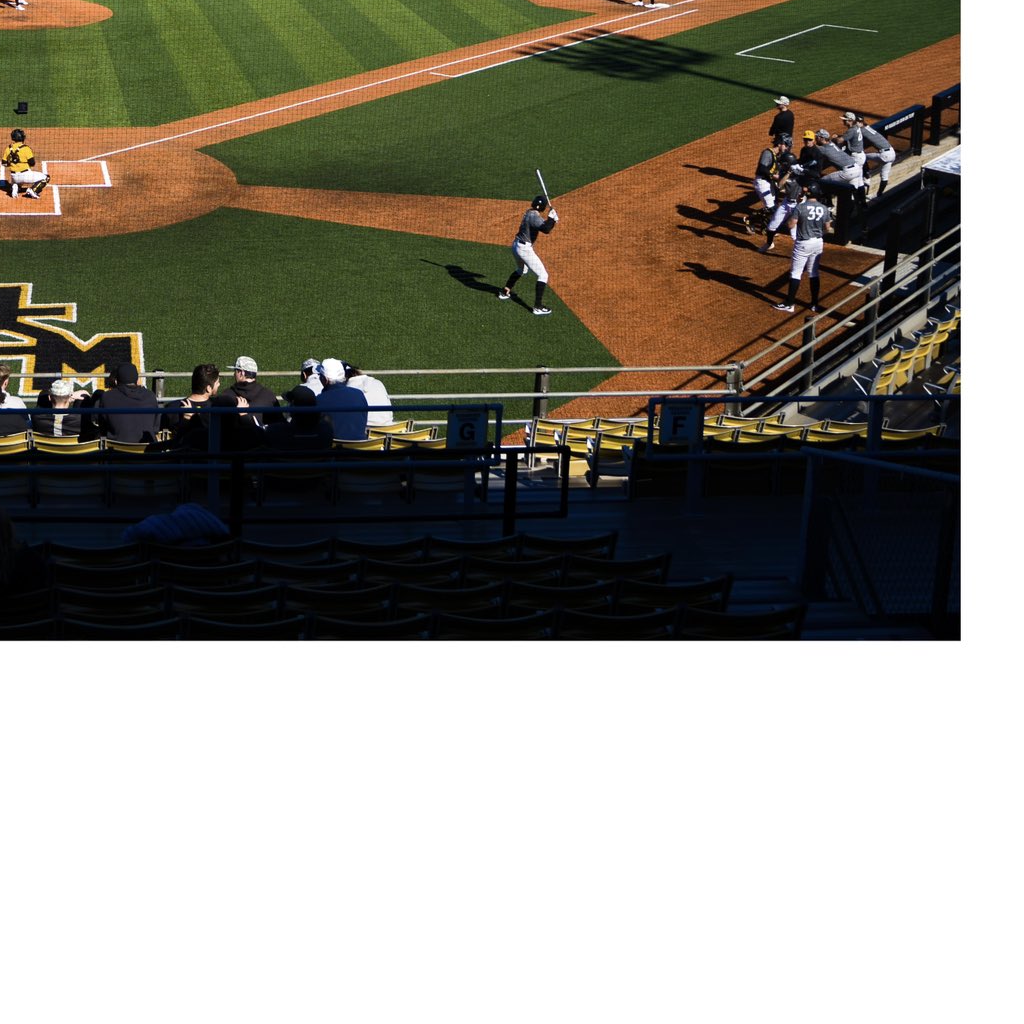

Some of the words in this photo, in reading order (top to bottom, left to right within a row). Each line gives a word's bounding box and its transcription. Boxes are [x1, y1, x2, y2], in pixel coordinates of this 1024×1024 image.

[806, 205, 824, 221] 39
[459, 422, 475, 441] G
[673, 416, 686, 435] F
